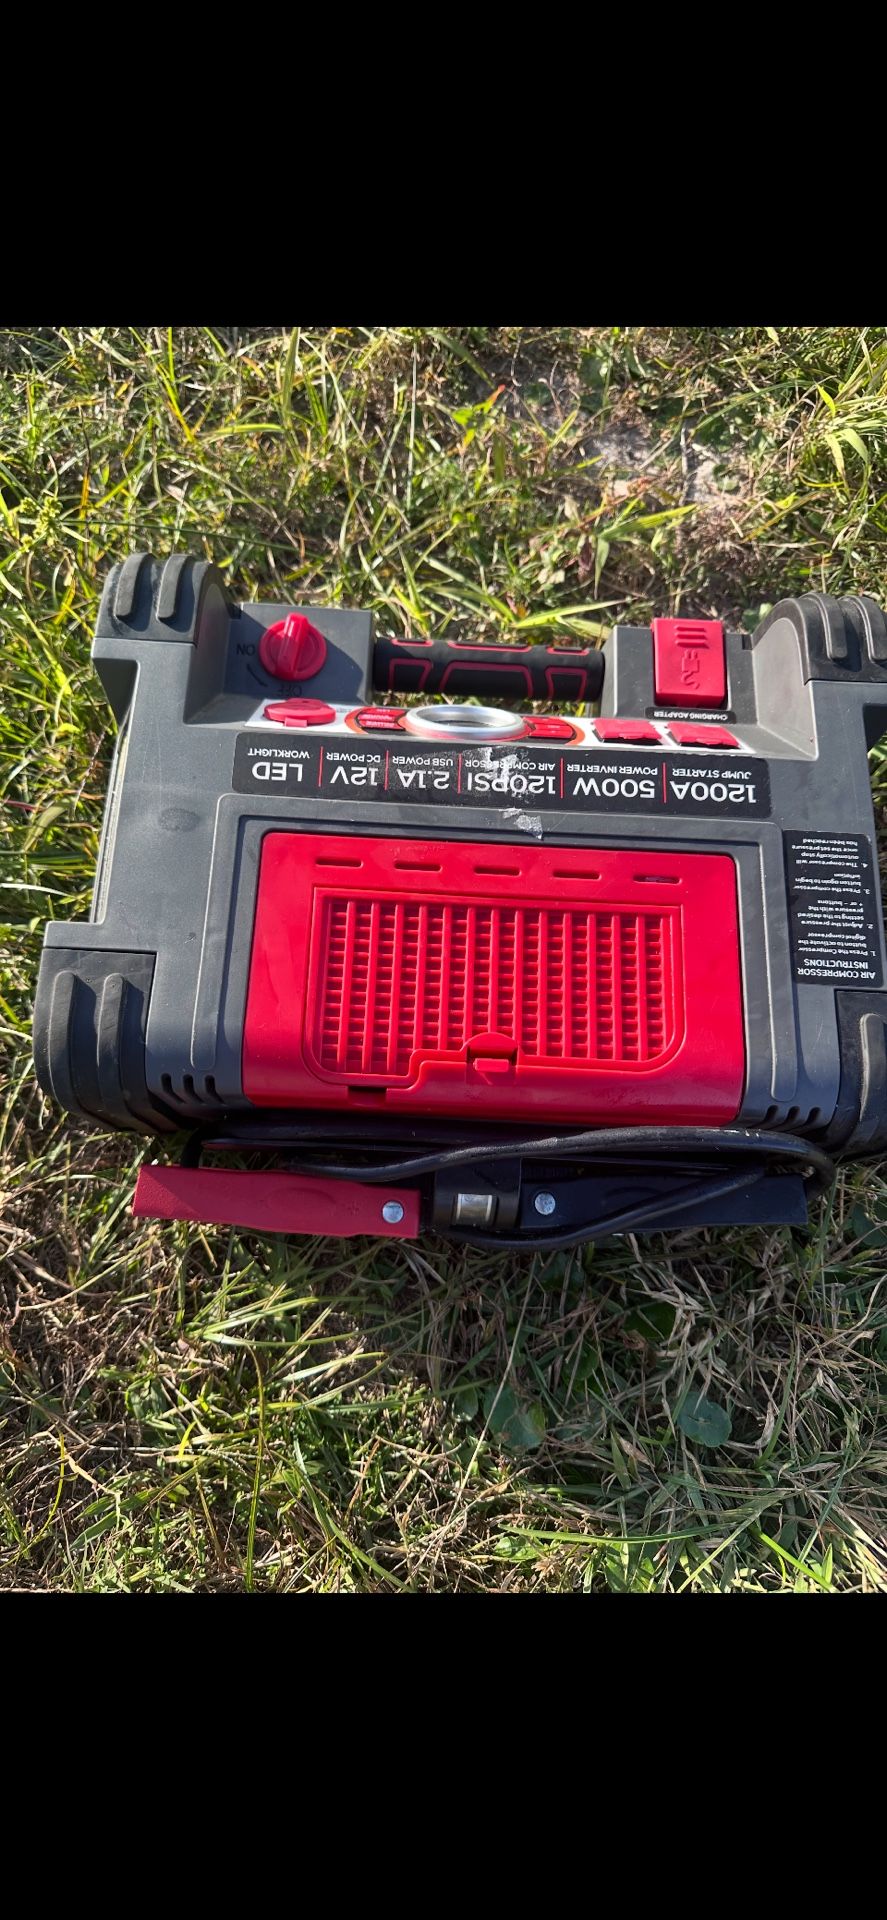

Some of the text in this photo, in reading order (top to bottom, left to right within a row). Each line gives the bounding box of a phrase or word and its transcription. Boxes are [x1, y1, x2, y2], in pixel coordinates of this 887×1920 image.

[236, 644, 256, 656] ON
[278, 685, 302, 696] OFF
[653, 711, 728, 721] CHARGING ADAPTER
[247, 747, 310, 759] WORKLIGHT
[326, 752, 381, 763] DC POWER
[392, 755, 453, 767] USB POWER
[251, 762, 303, 782] LED
[567, 763, 658, 775] POWER INVERTER
[672, 768, 752, 780] JUMP STARTER
[330, 766, 379, 786] 12V
[397, 768, 450, 789] 2.1A
[467, 772, 556, 795] 120PSI
[573, 777, 655, 798] 500W
[669, 780, 757, 803] 1200A
[804, 959, 868, 969] INSTRUCTIONS
[797, 968, 875, 979] AIR COMPRESSOR
